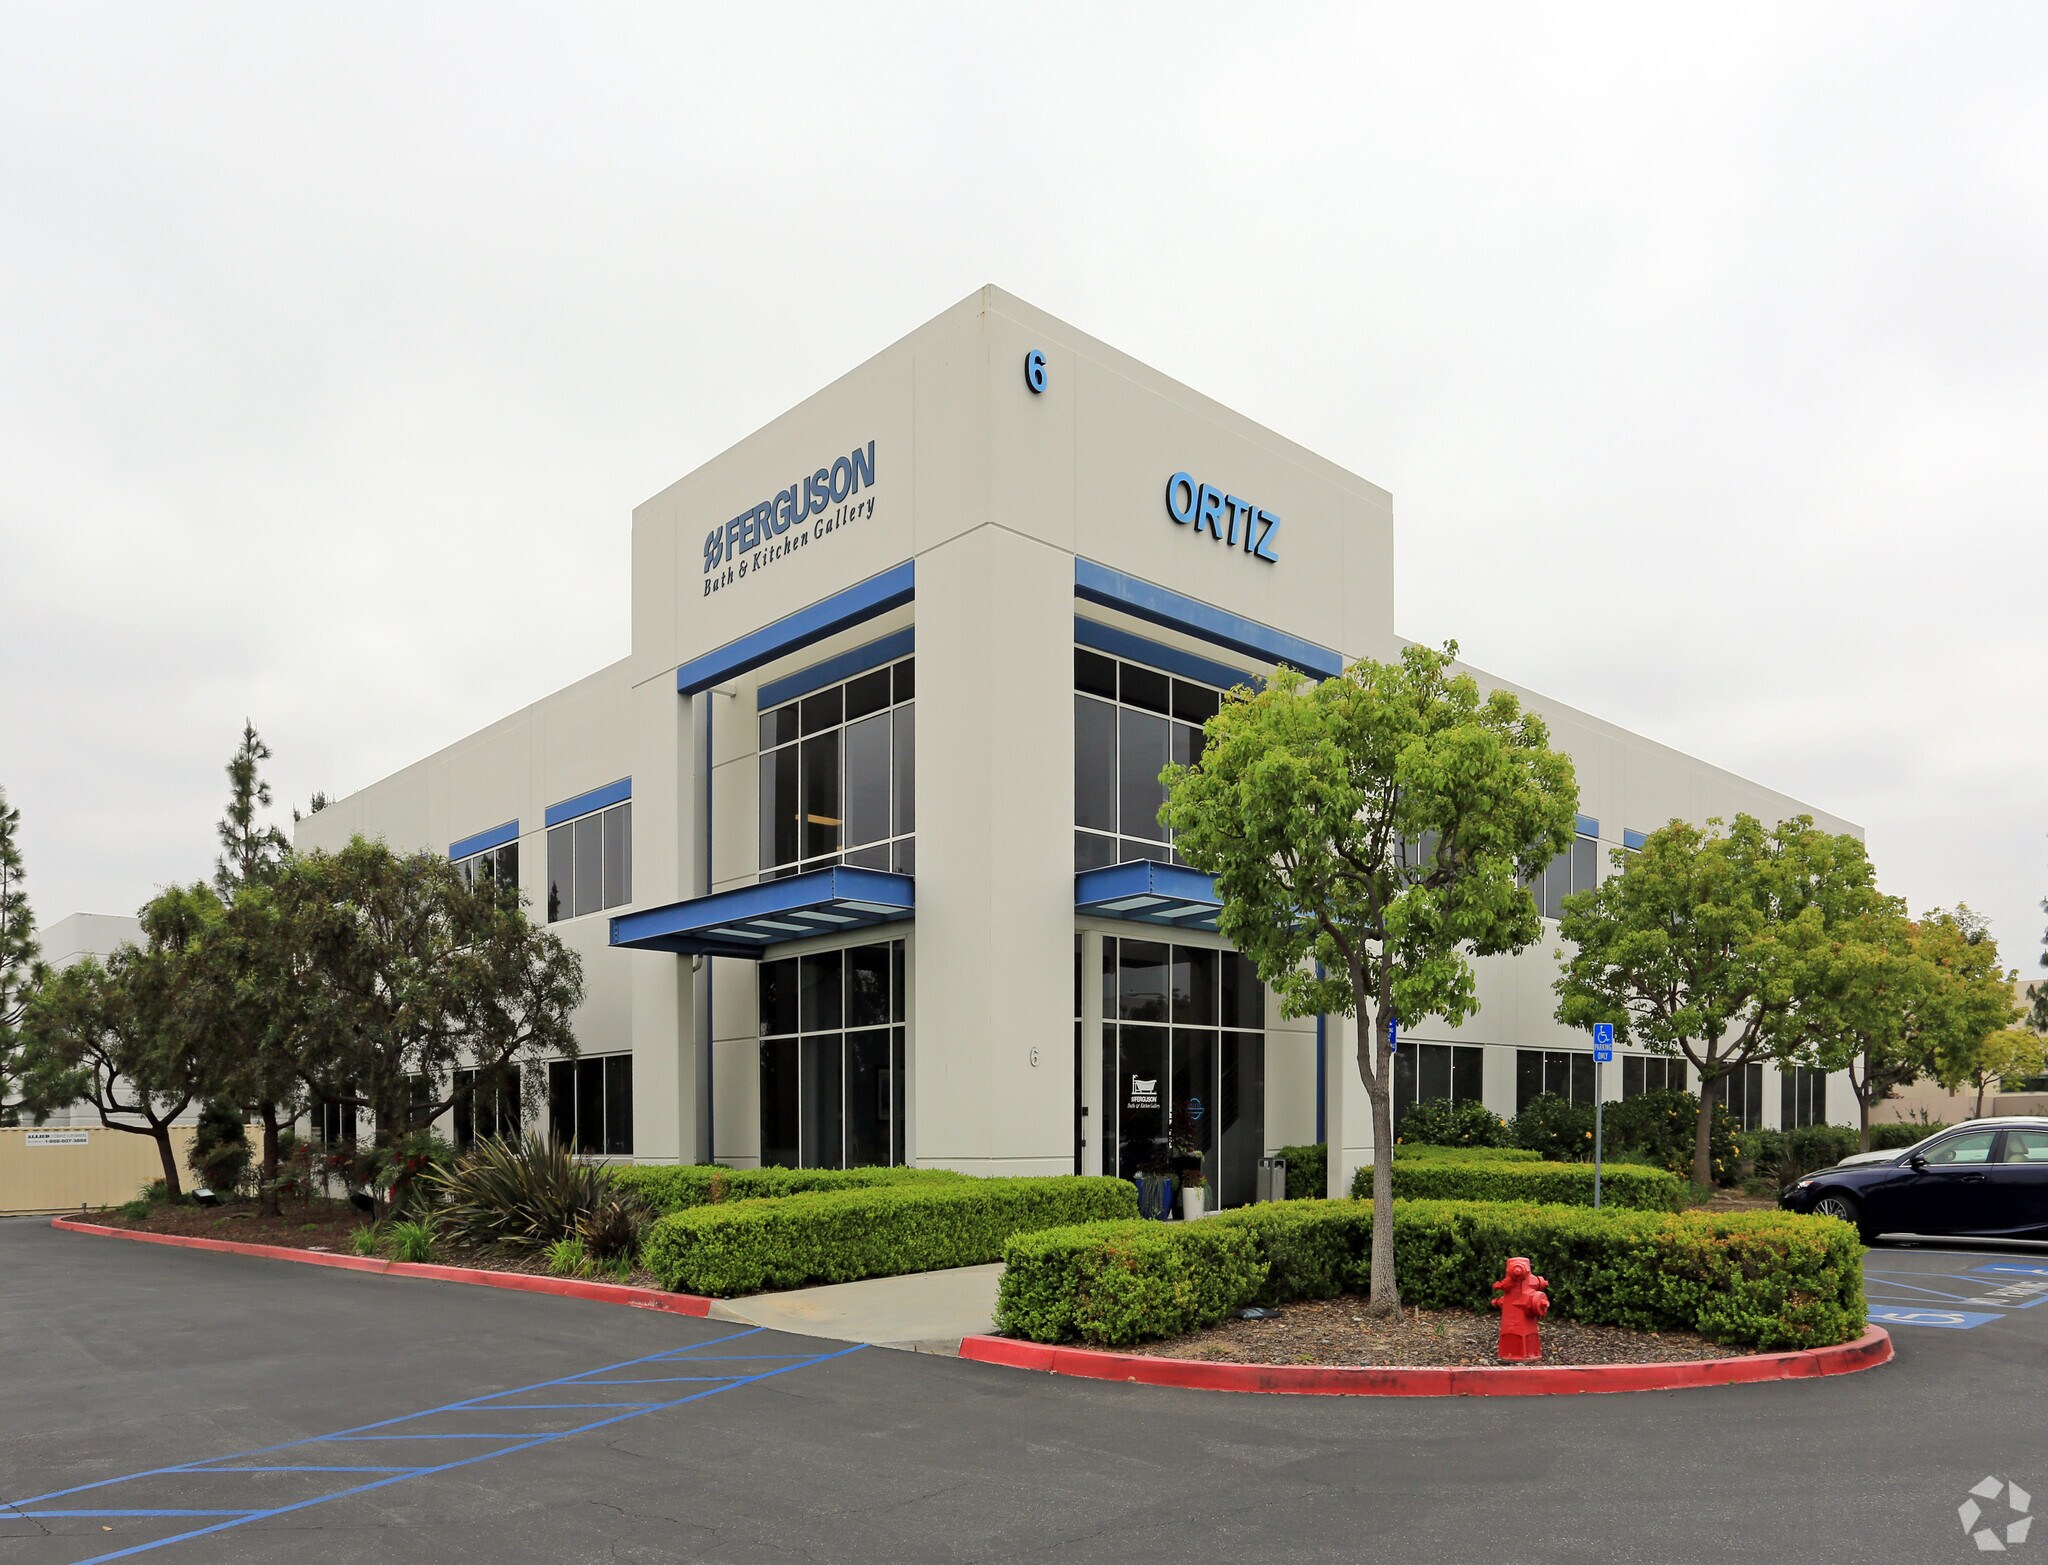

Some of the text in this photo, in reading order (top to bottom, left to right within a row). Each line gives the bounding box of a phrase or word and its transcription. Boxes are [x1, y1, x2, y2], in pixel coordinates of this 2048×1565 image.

[1024, 349, 1048, 394] 6
[703, 496, 875, 597] Bath & Kitchen Gallery
[725, 440, 875, 562] FERGUSON
[1165, 471, 1281, 563] ORTIZ
[1029, 1046, 1040, 1068] 6
